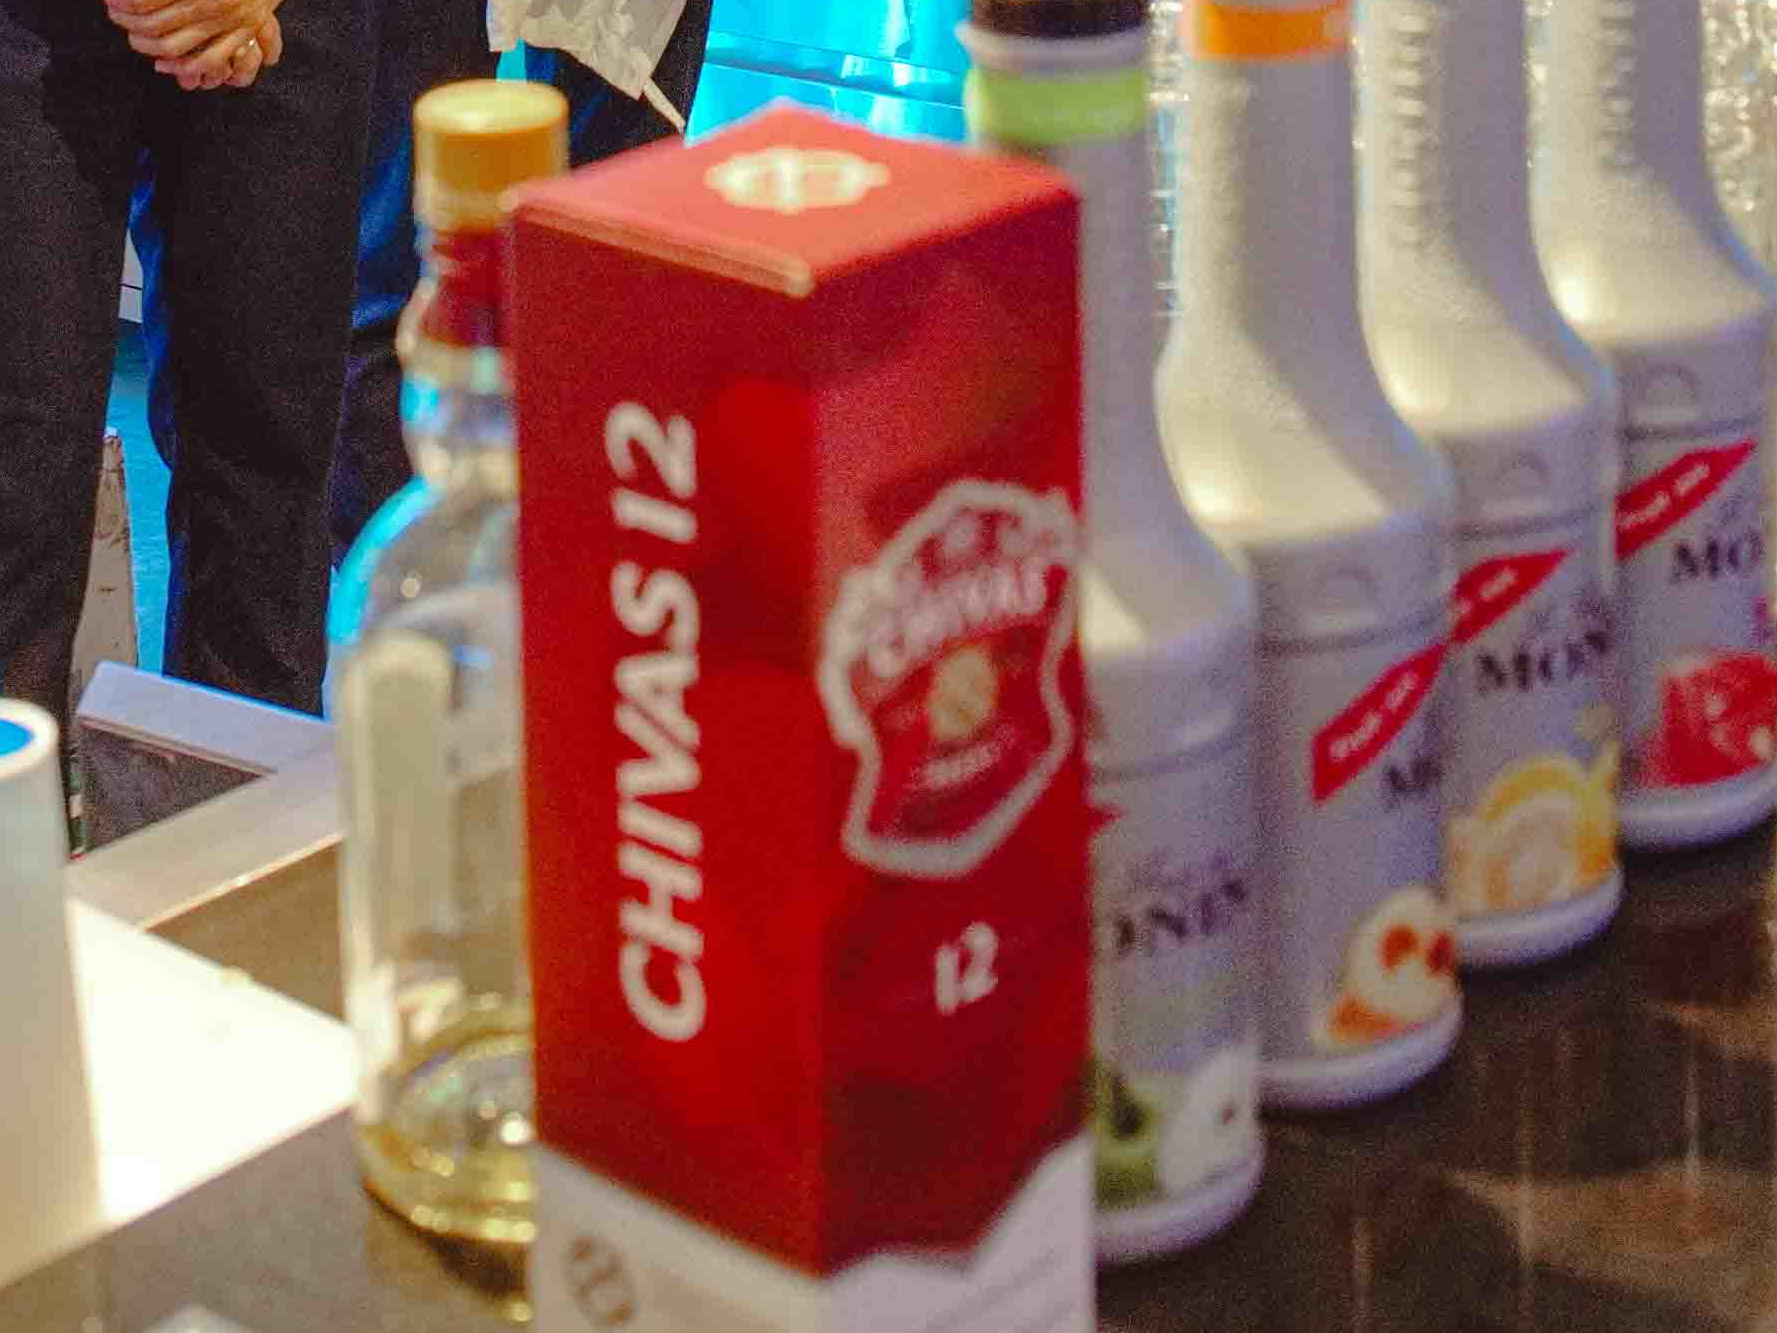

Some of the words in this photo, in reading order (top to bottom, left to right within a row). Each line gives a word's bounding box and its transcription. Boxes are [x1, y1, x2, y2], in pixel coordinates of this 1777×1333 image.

[605, 400, 698, 544] 12
[610, 559, 707, 1042] CHIVAS
[935, 921, 999, 1015] 12
